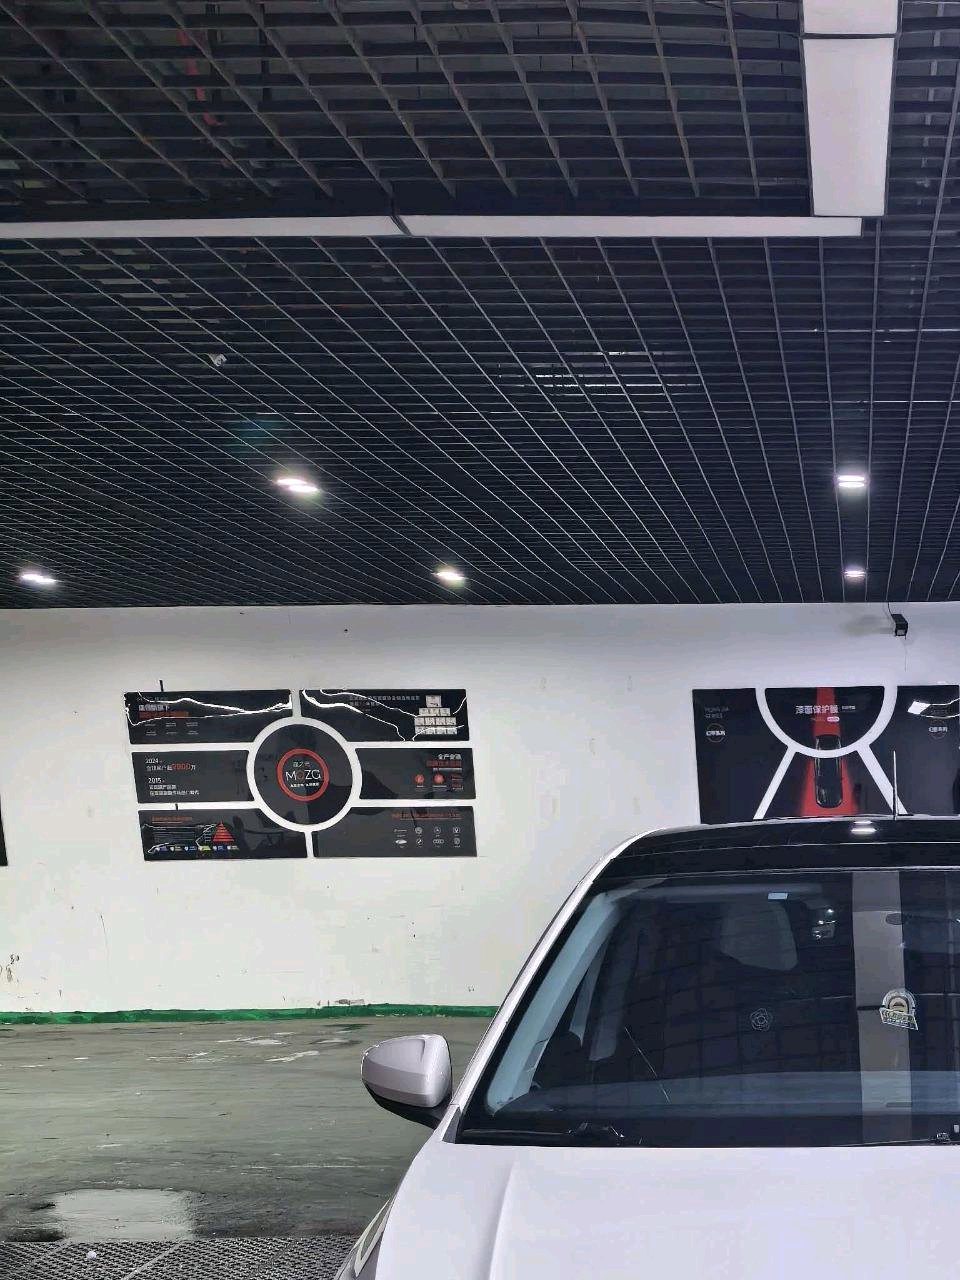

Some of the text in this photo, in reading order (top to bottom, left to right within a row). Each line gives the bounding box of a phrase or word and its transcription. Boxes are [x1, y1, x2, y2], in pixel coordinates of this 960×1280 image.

[795, 704, 839, 714] 漆面保护膜
